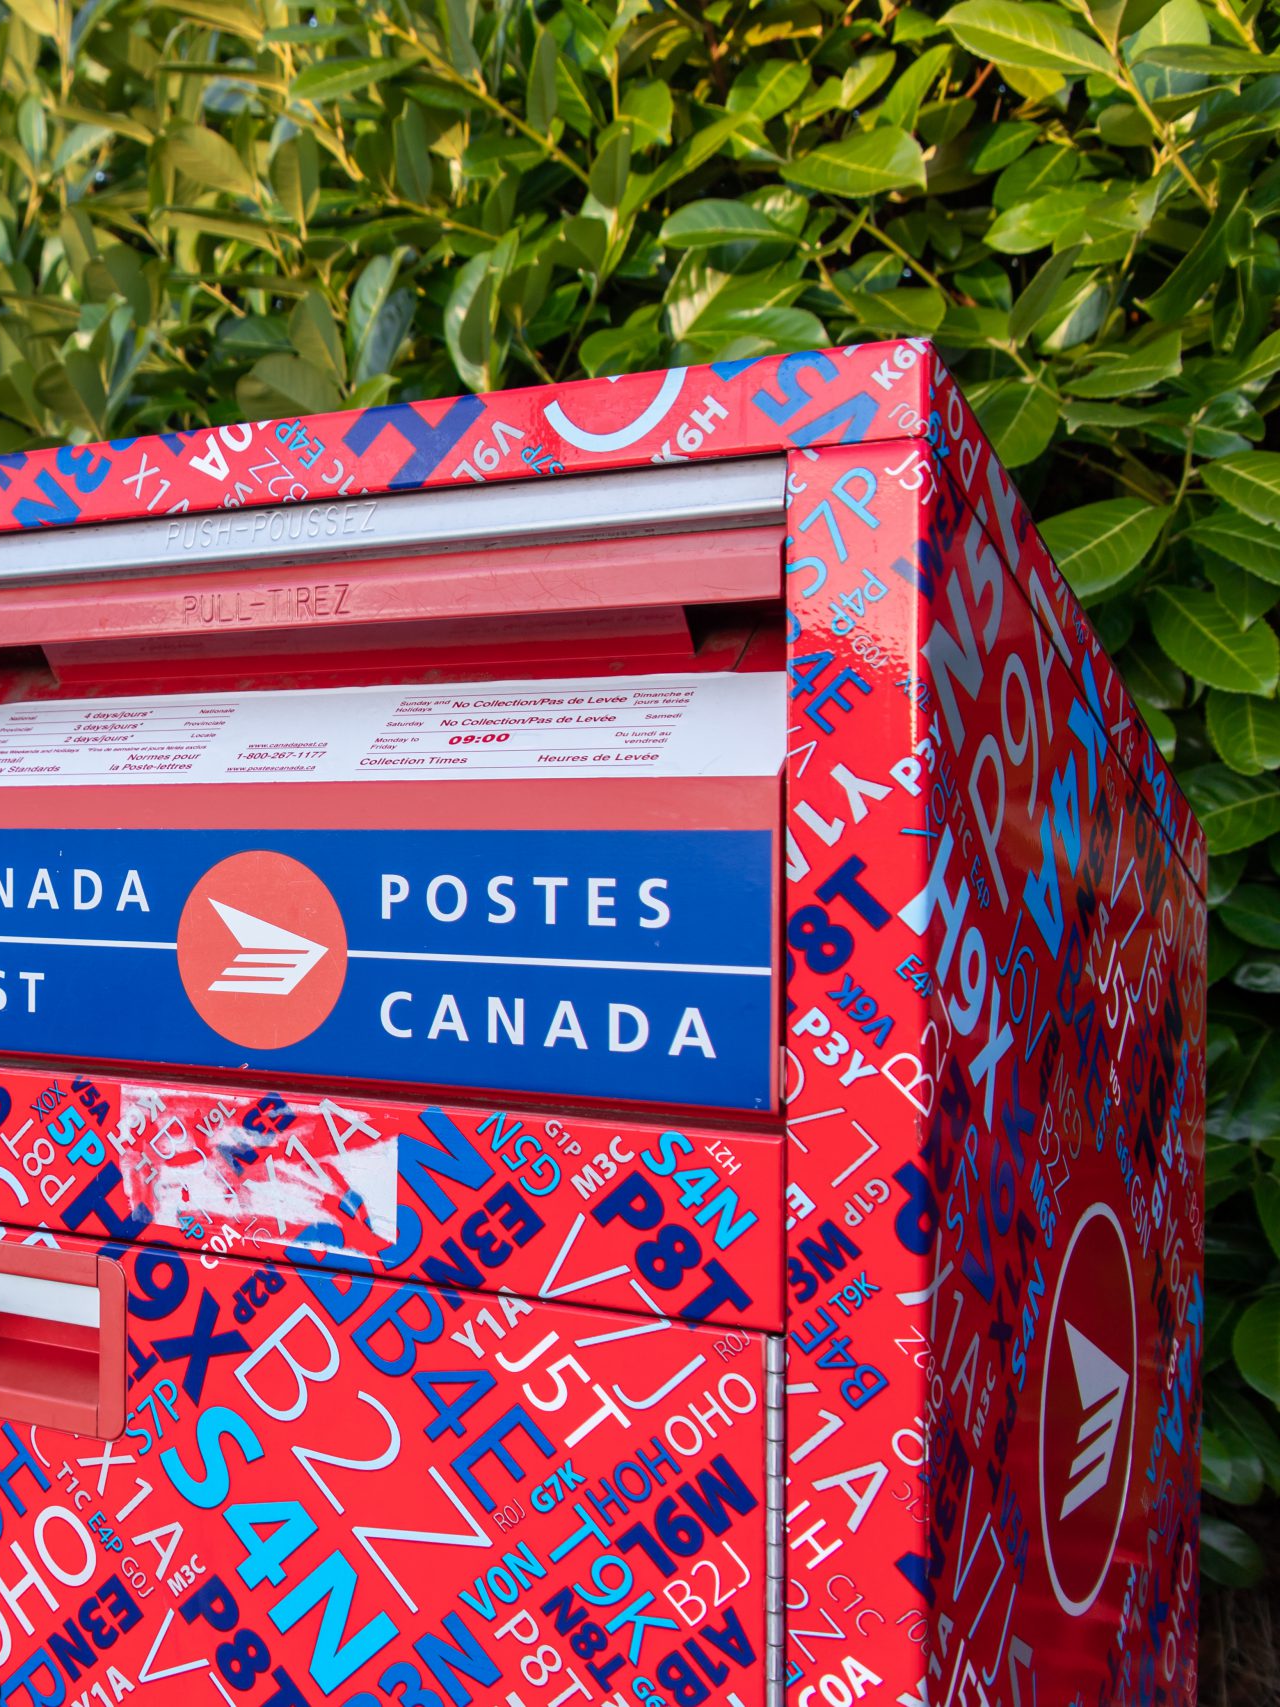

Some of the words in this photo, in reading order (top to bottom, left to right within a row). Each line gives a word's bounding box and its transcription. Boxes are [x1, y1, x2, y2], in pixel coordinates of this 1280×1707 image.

[166, 501, 378, 550] PUSH-POUSSEZ
[183, 584, 351, 625] PULL-TIREZ
[439, 719, 459, 727] No
[460, 716, 553, 727] Collection/Pas
[575, 714, 617, 723] Levée
[472, 698, 565, 708] Collection/Pas
[567, 697, 585, 705] de
[587, 696, 628, 704] Levée
[121, 763, 193, 771] Poste-lettres
[127, 753, 170, 761] Normes
[171, 753, 201, 761] pour
[236, 751, 327, 760] 1-800-267-1177
[359, 757, 426, 766] Collection
[427, 756, 469, 764] Times
[448, 733, 511, 745] 09:00
[537, 754, 589, 763] Heures
[591, 753, 611, 761] de
[614, 752, 660, 761] Levée
[7, 765, 61, 773] Standards
[380, 873, 671, 929] POSTES
[379, 990, 717, 1059] CANADA
[791, 1006, 880, 1088] P3Y
[195, 1100, 236, 1139] V9L
[544, 1119, 583, 1157] G1P
[569, 1135, 636, 1201] M3C
[640, 1130, 760, 1251] S4N
[420, 1181, 546, 1312] E3N
[590, 1170, 754, 1330] P8T
[827, 1271, 881, 1316] T9K
[450, 1285, 535, 1360] Y1A
[125, 1379, 180, 1456] S7P
[351, 1265, 558, 1514] B4E
[494, 1330, 632, 1449] J5T
[56, 1460, 92, 1510] T1C
[233, 1302, 494, 1615] B2Z
[529, 1458, 587, 1514] G7K
[76, 1441, 184, 1582] X1A
[87, 1510, 124, 1554] E4P
[160, 1405, 401, 1697] S4N
[166, 1553, 207, 1598] M3C
[548, 1502, 682, 1668] T9K
[662, 1540, 752, 1628] B2J
[46, 1573, 145, 1683] E3N
